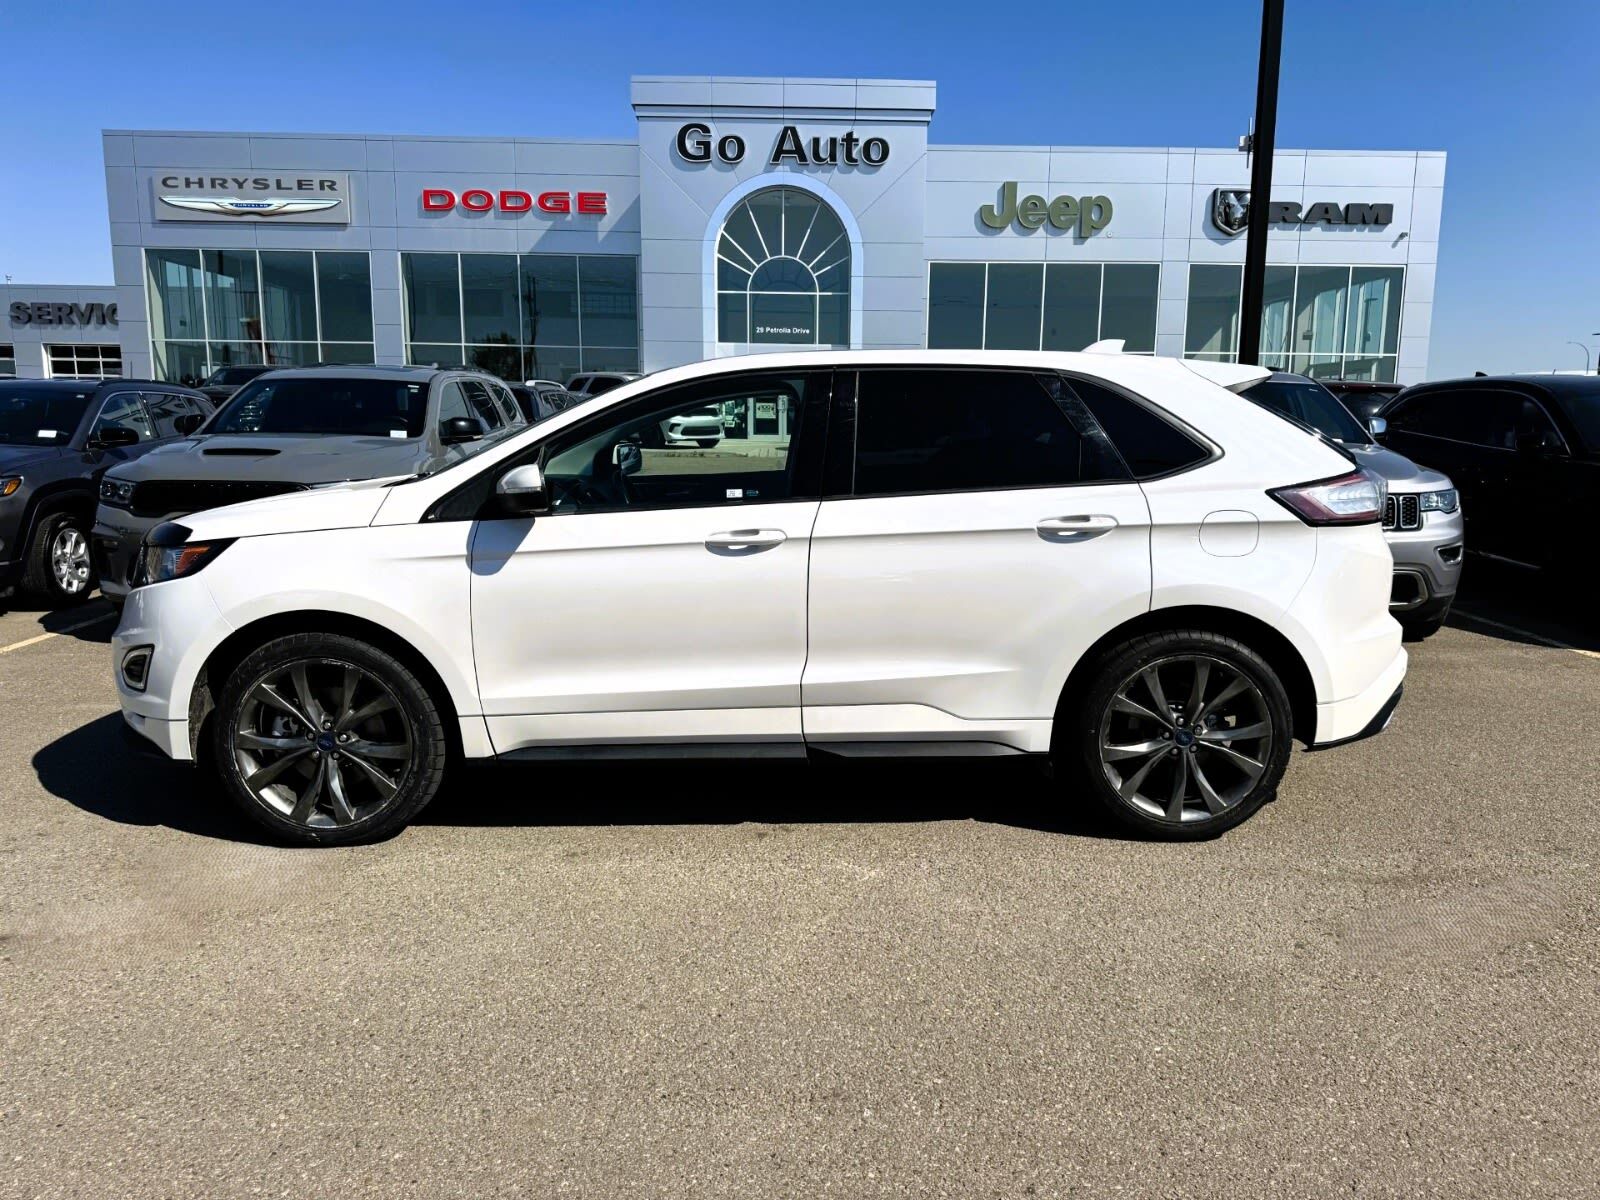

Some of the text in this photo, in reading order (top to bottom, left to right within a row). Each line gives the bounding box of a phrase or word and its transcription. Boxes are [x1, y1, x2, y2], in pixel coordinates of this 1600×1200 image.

[676, 122, 890, 166] Go Auto
[161, 176, 338, 191] CHRYSLER
[422, 189, 608, 215] DODGE
[981, 181, 1113, 239] Jeep
[1268, 201, 1394, 225] RAM
[792, 327, 810, 335] Drive
